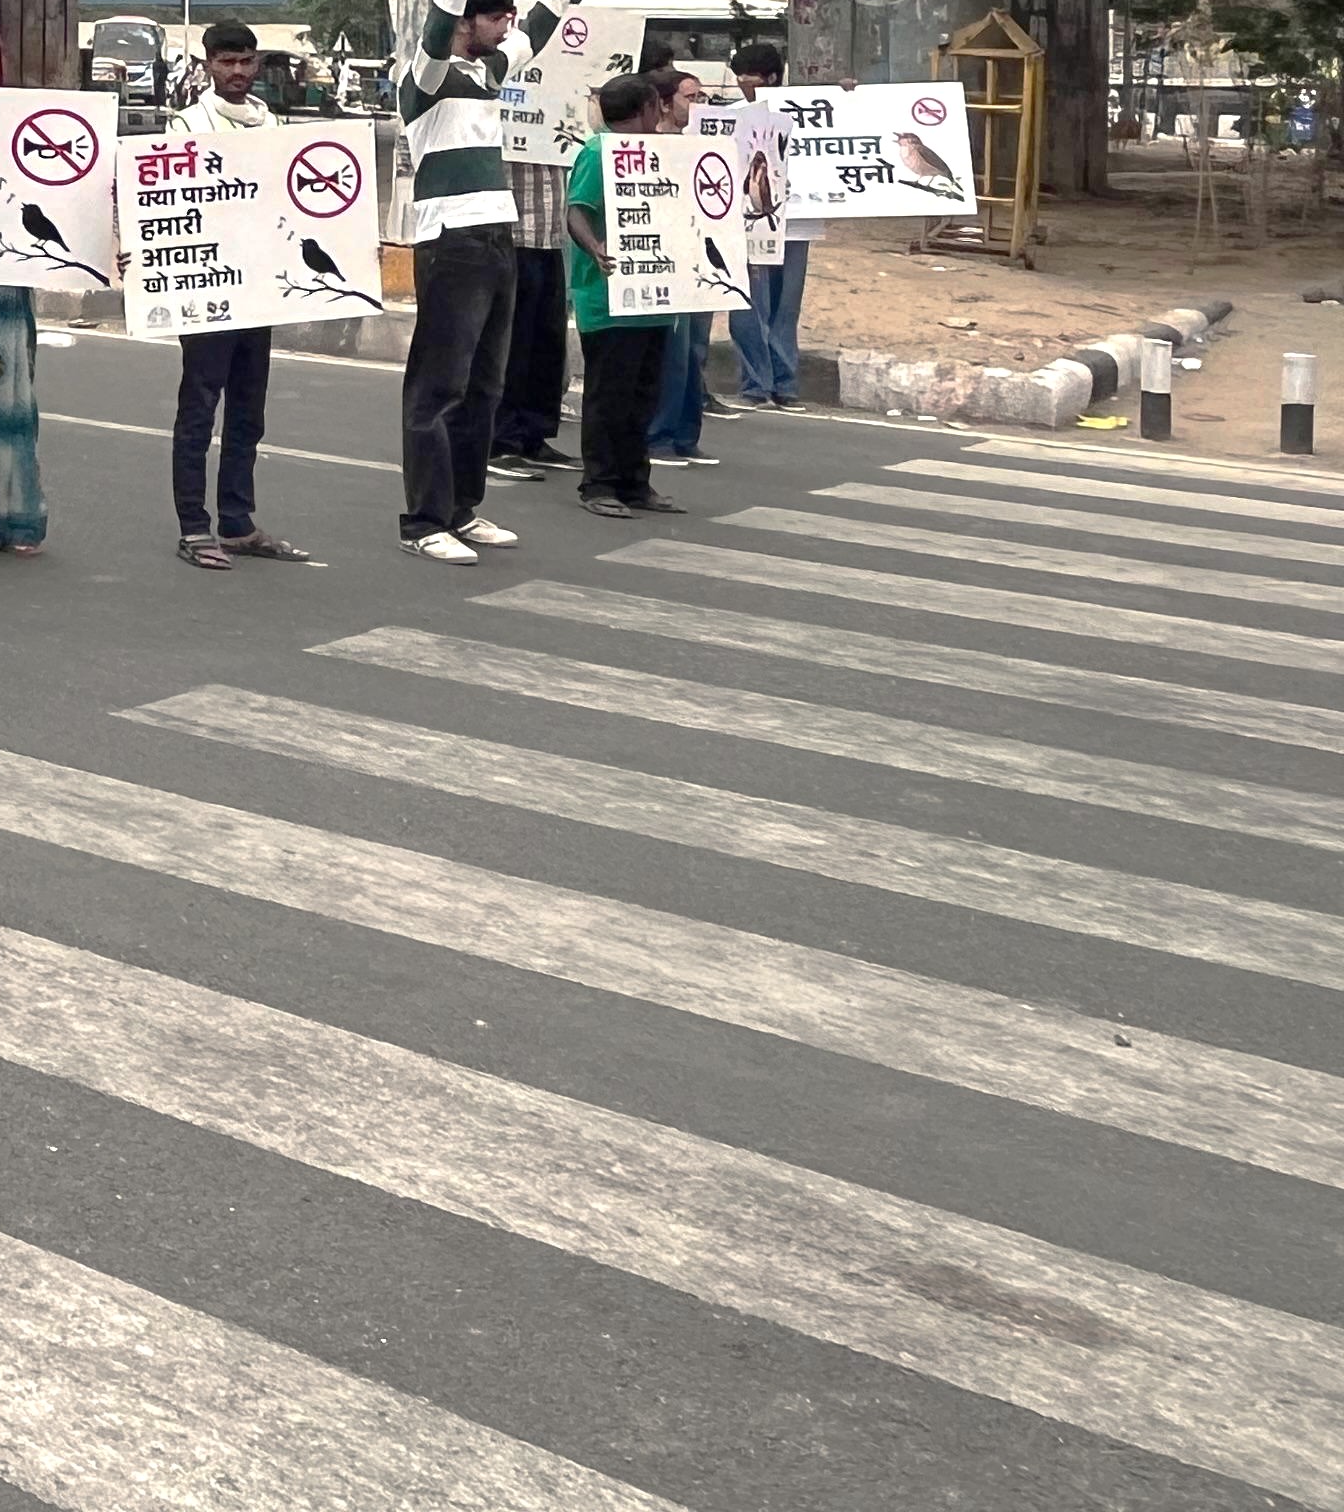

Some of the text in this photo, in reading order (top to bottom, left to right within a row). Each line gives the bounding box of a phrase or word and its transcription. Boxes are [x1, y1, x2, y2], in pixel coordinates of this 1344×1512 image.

[135, 141, 223, 185] हॉर्न से
[612, 140, 646, 178] हॉर्न
[789, 136, 881, 160] आवाज़
[836, 158, 895, 193] सुनो
[138, 178, 258, 207] क्या पाओगे?
[139, 208, 202, 240] हमारी
[142, 243, 218, 268] आवाज़
[142, 272, 169, 293] खो
